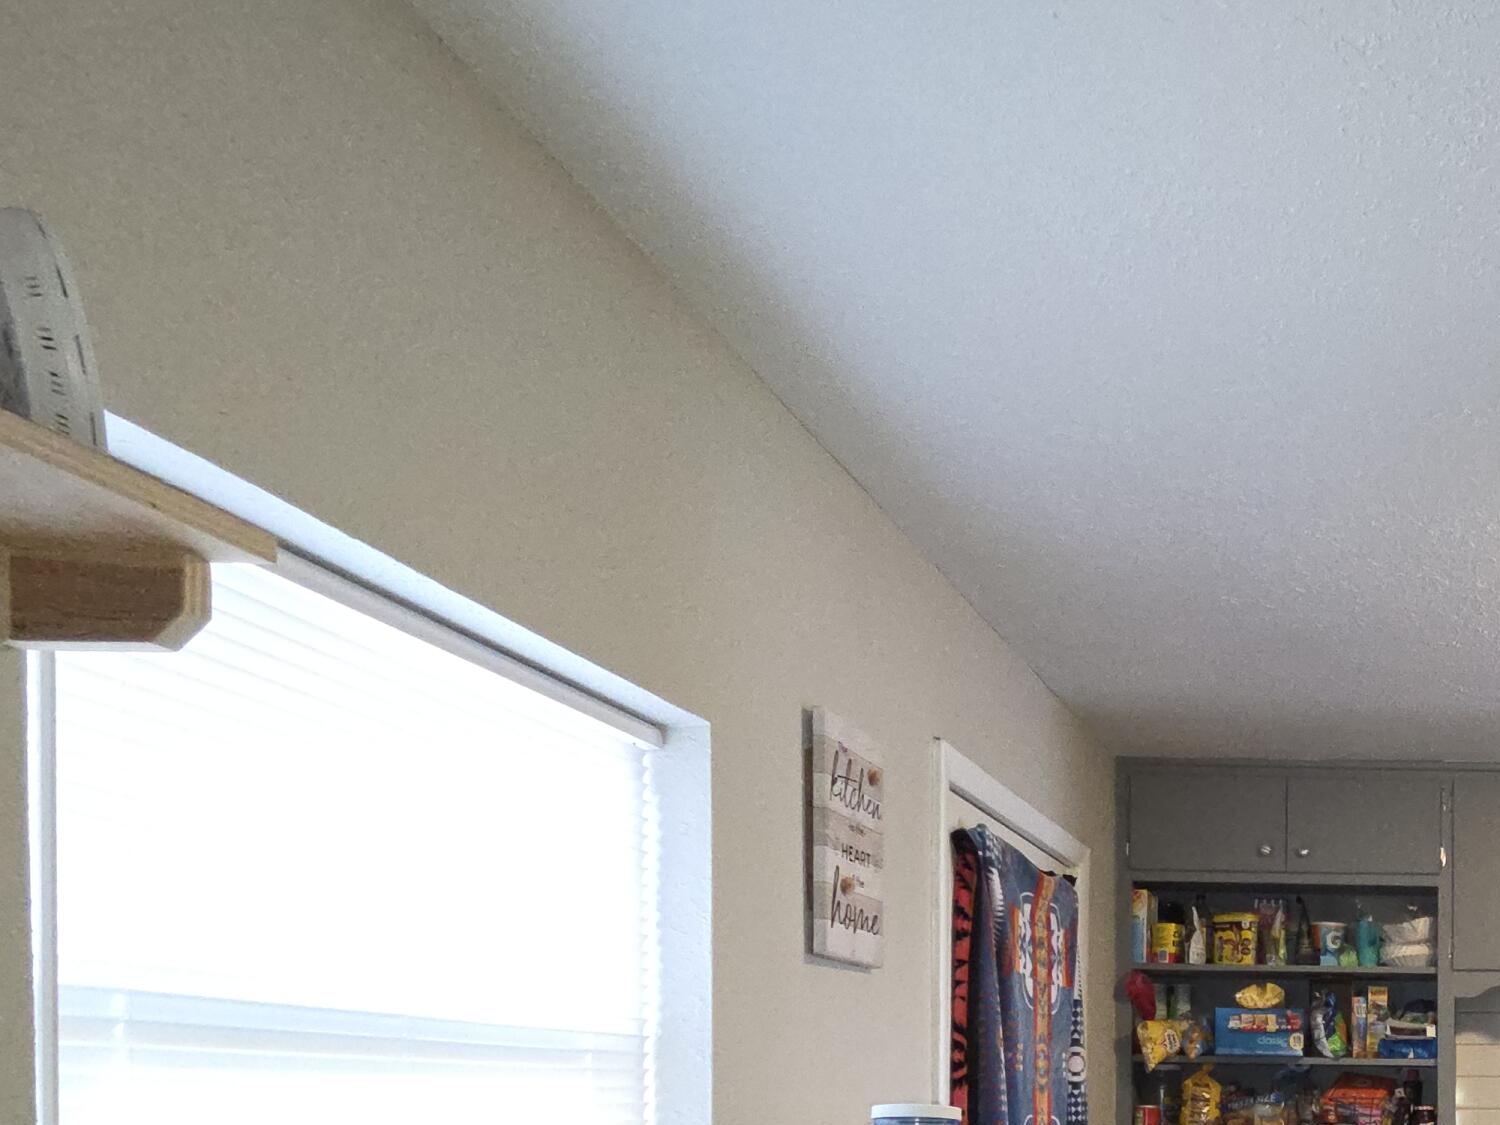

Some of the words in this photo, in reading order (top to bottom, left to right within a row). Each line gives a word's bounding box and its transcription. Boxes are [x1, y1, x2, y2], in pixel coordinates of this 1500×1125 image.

[830, 750, 881, 820] kitchen
[841, 842, 871, 865] HEART
[830, 865, 880, 935] home
